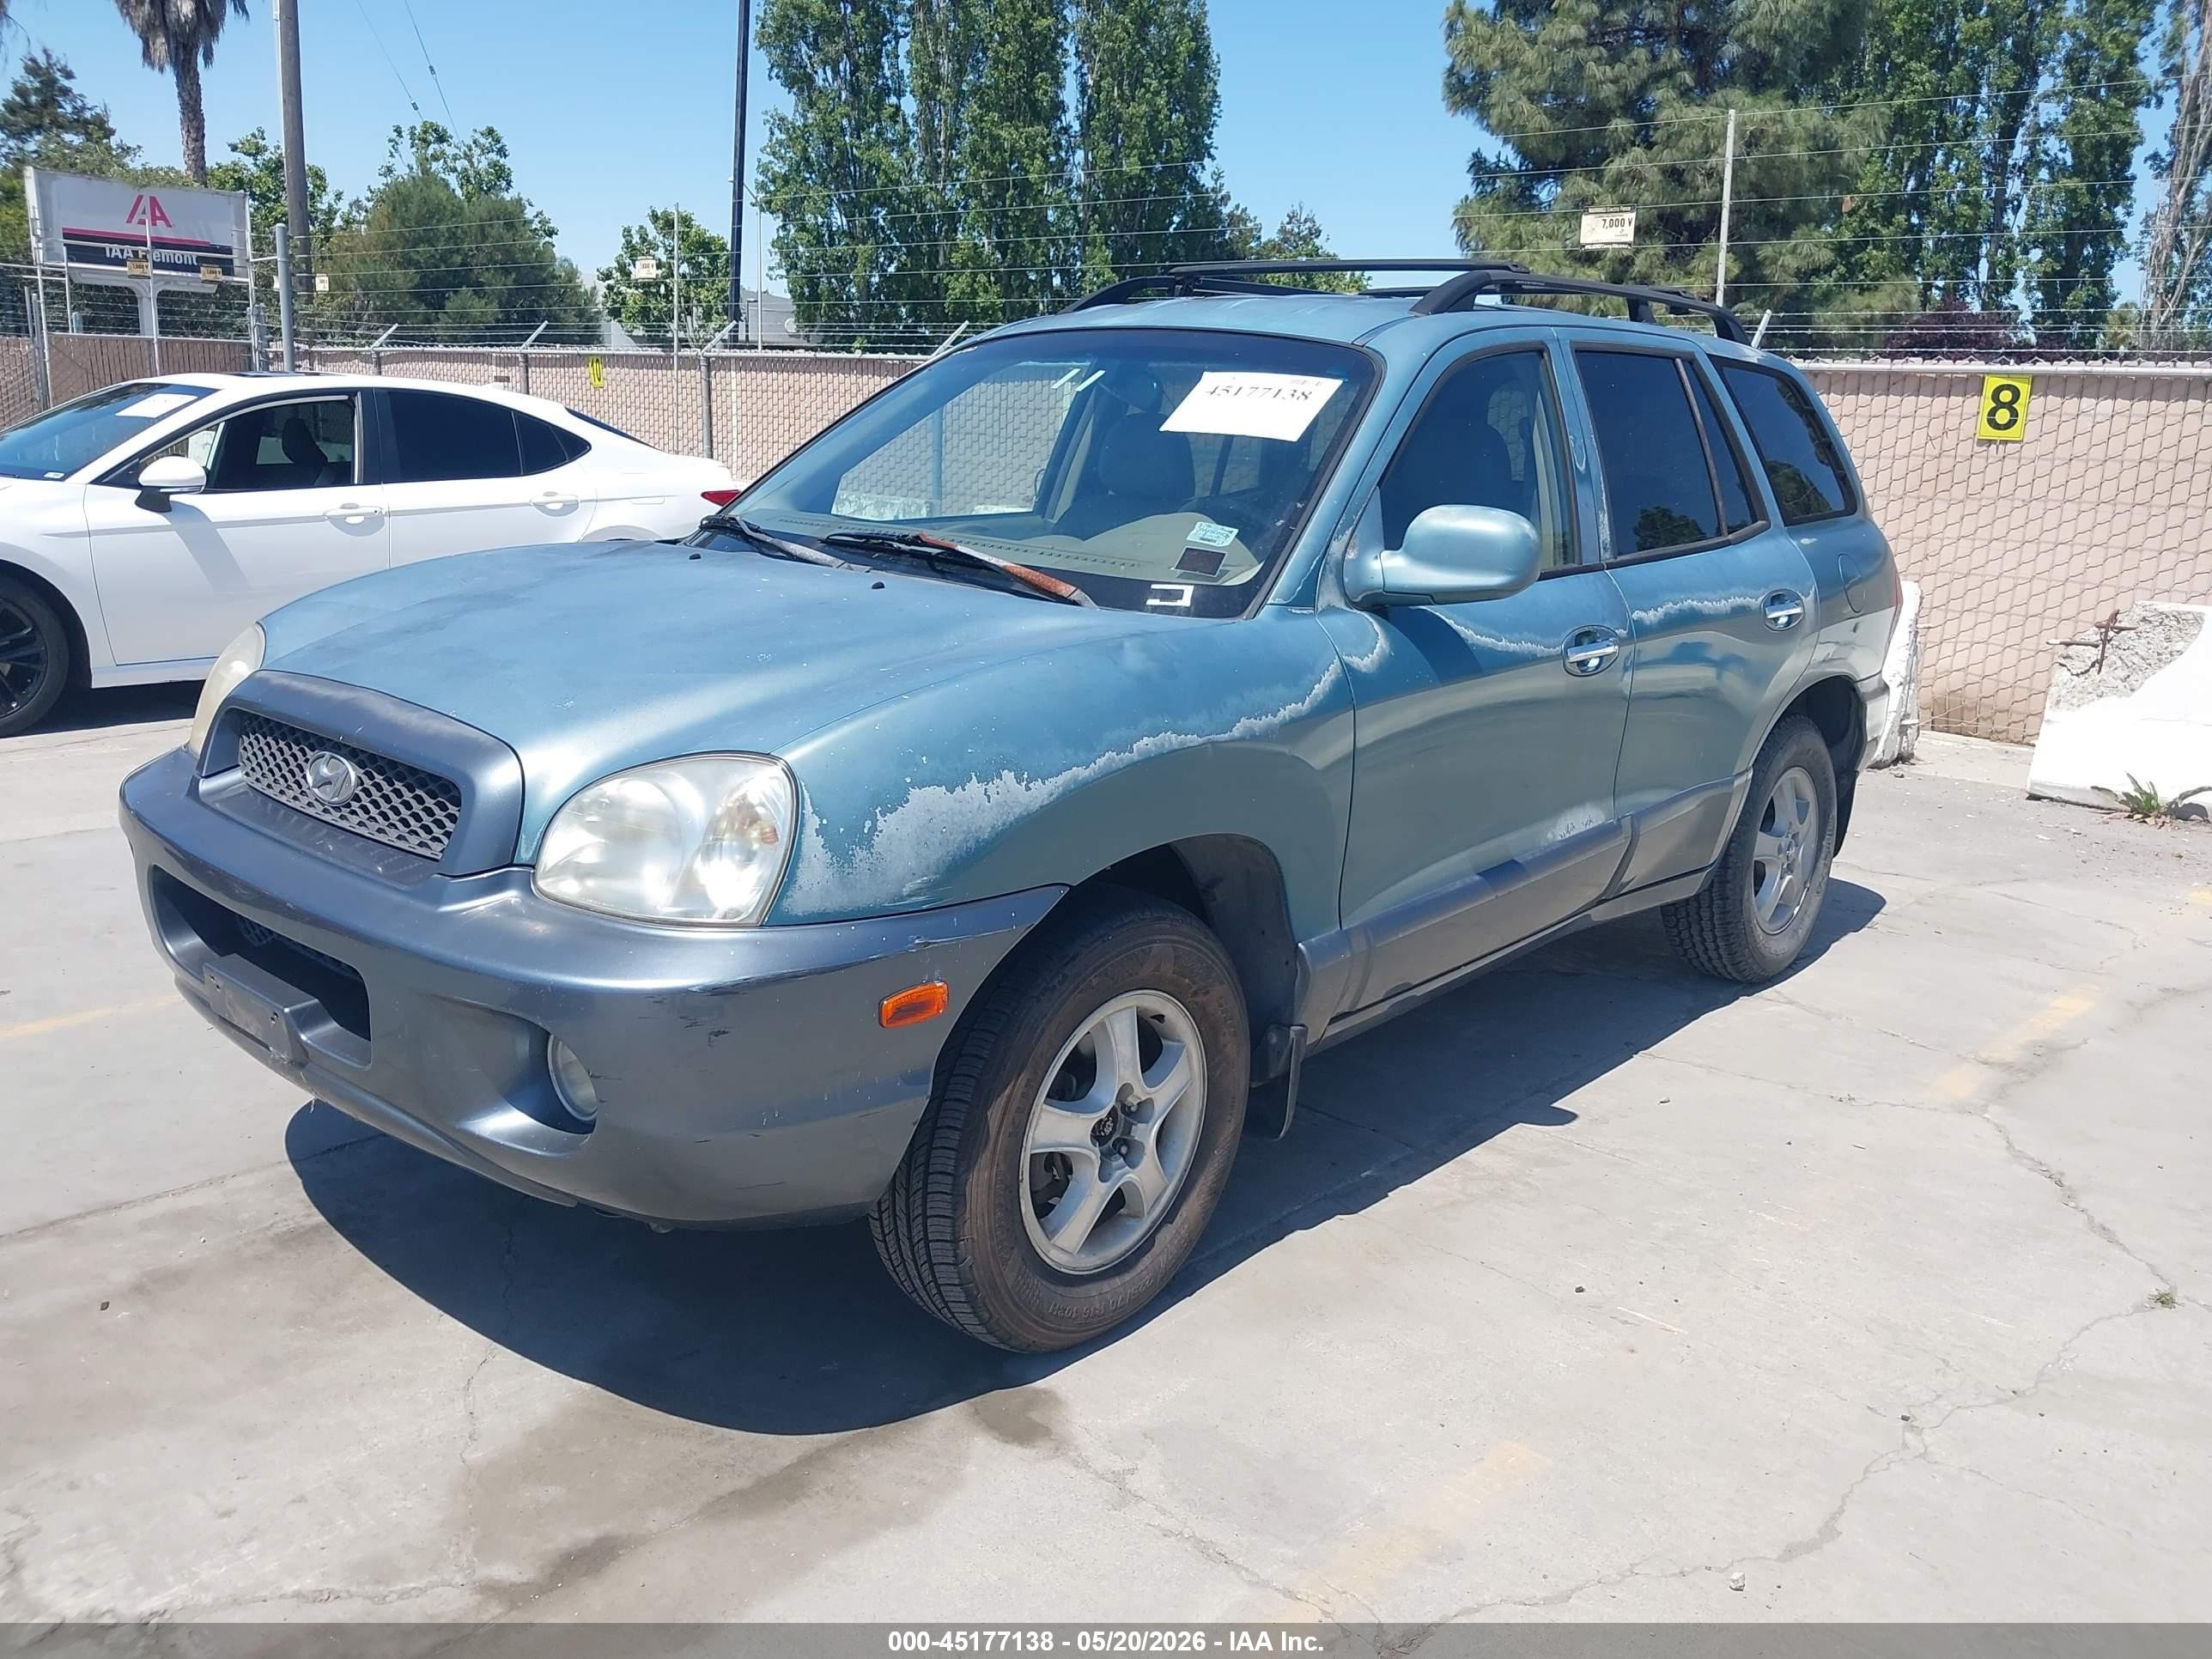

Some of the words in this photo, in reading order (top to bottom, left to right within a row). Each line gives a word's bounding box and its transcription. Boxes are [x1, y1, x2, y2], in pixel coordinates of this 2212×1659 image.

[1601, 218, 1626, 229] 7,000
[1627, 217, 1633, 228] V
[138, 248, 198, 266] Femont
[1204, 385, 1314, 401] 45177138
[1986, 383, 2021, 431] 8
